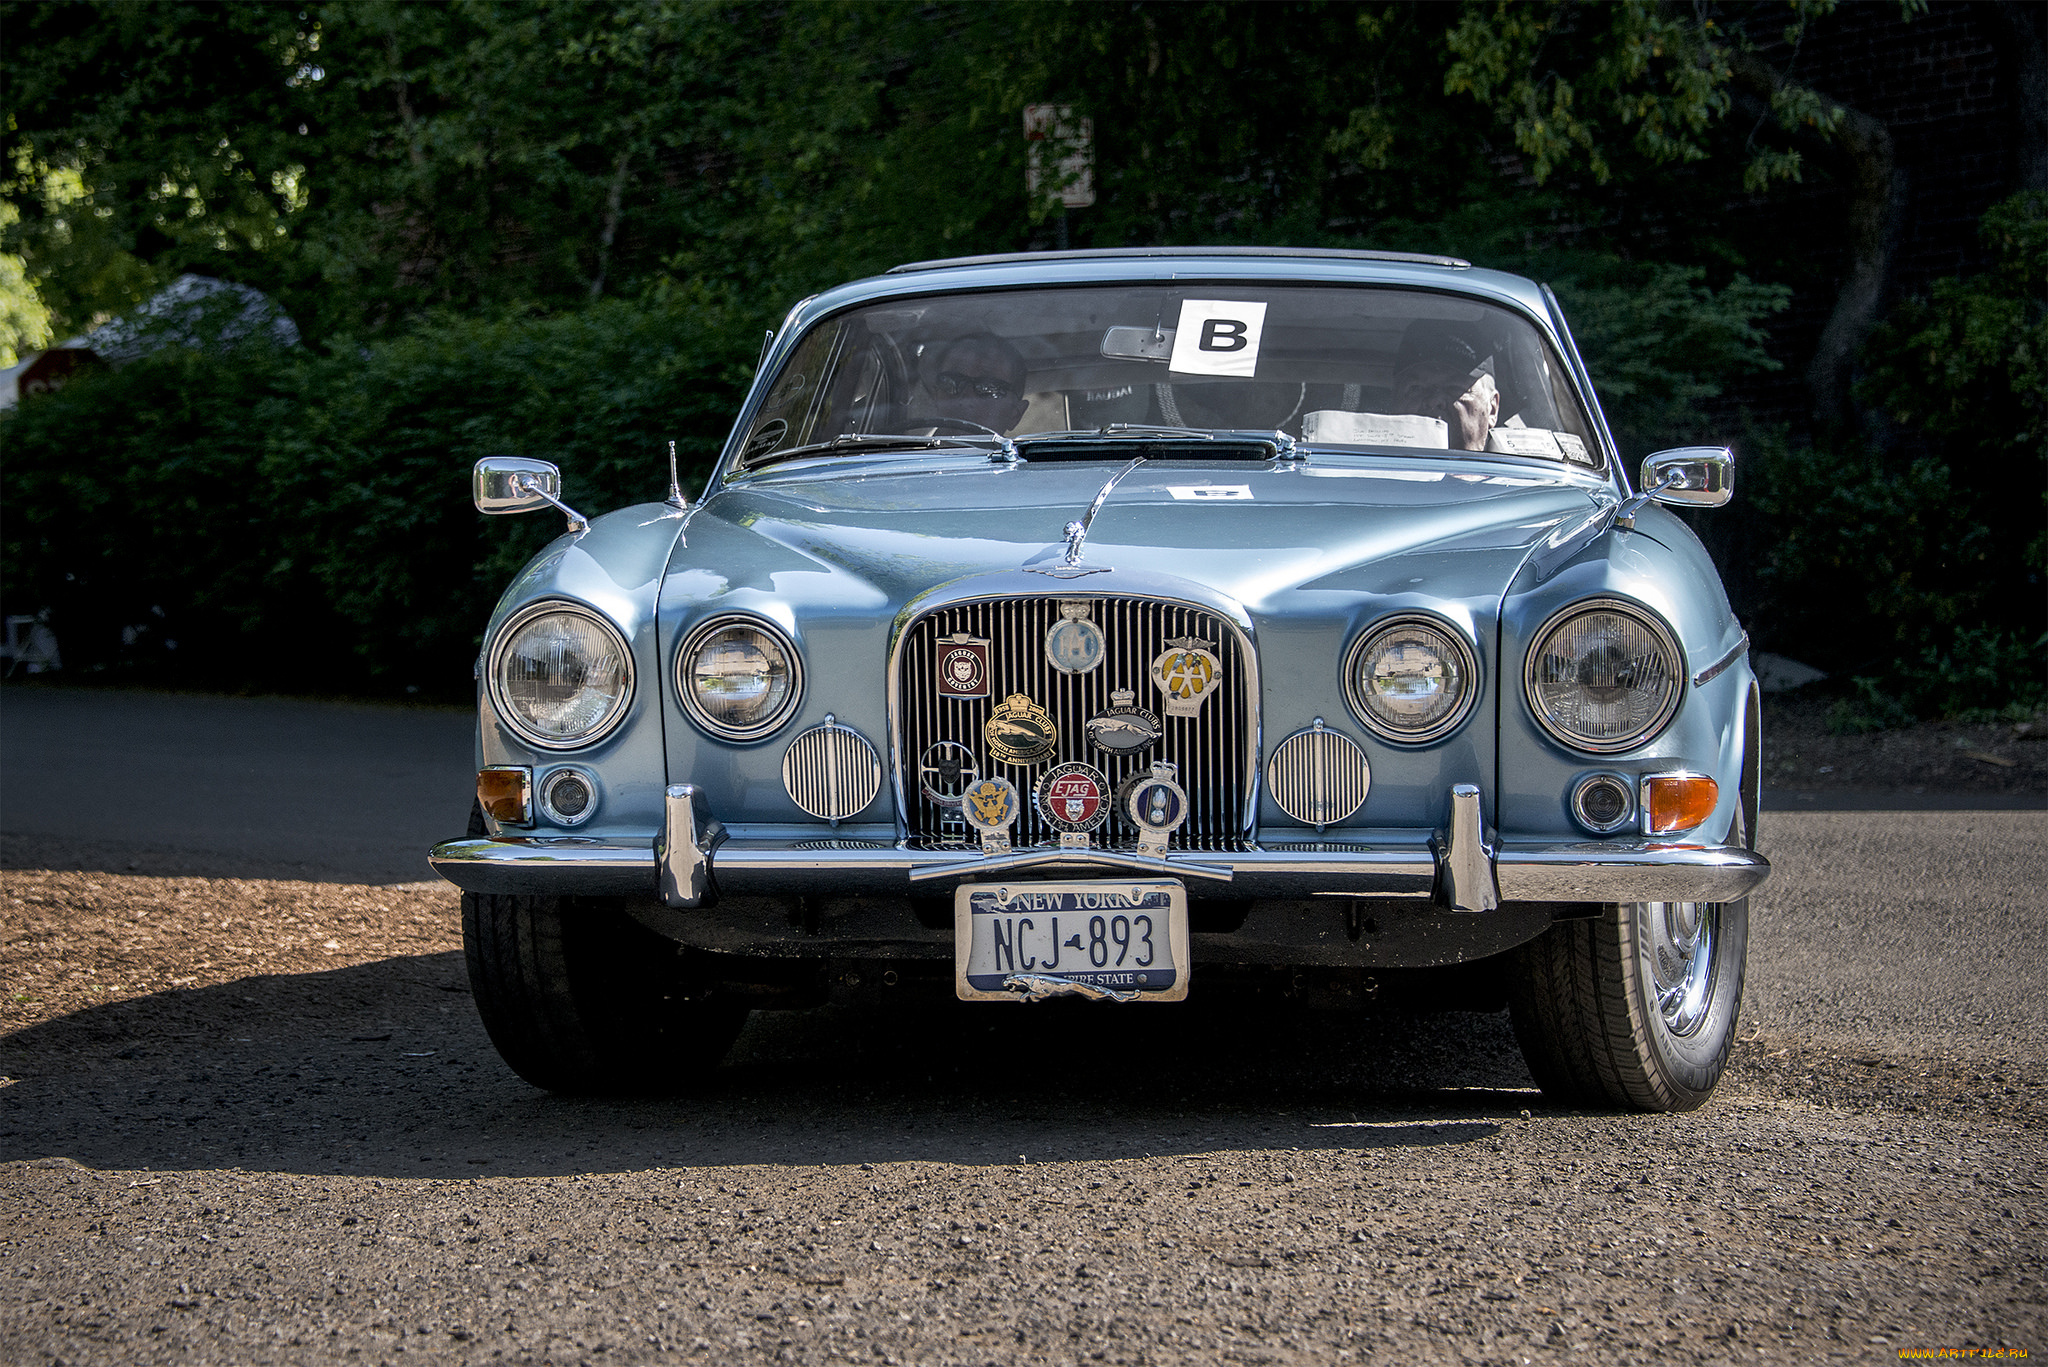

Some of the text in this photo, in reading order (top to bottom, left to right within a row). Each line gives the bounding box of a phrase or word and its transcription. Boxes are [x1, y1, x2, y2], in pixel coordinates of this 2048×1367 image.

[1199, 319, 1247, 352] B
[951, 650, 975, 659] JAGUAR
[947, 677, 979, 689] COVENTRY
[1165, 653, 1208, 695] AA
[1005, 712, 1052, 734] JAGUAR CLUBS
[1106, 707, 1161, 730] JAGUAR CLUBS
[991, 736, 1010, 753] NORTH
[1093, 739, 1114, 753] NORTH
[1007, 752, 1051, 764] ANNIVERSARY
[1051, 764, 1099, 781] JAGUAR
[1040, 792, 1109, 832] NORTH AMERICA
[1014, 891, 1131, 911] NEW YORK
[993, 914, 1154, 971] NCJ 893
[1097, 973, 1134, 985] STATE
